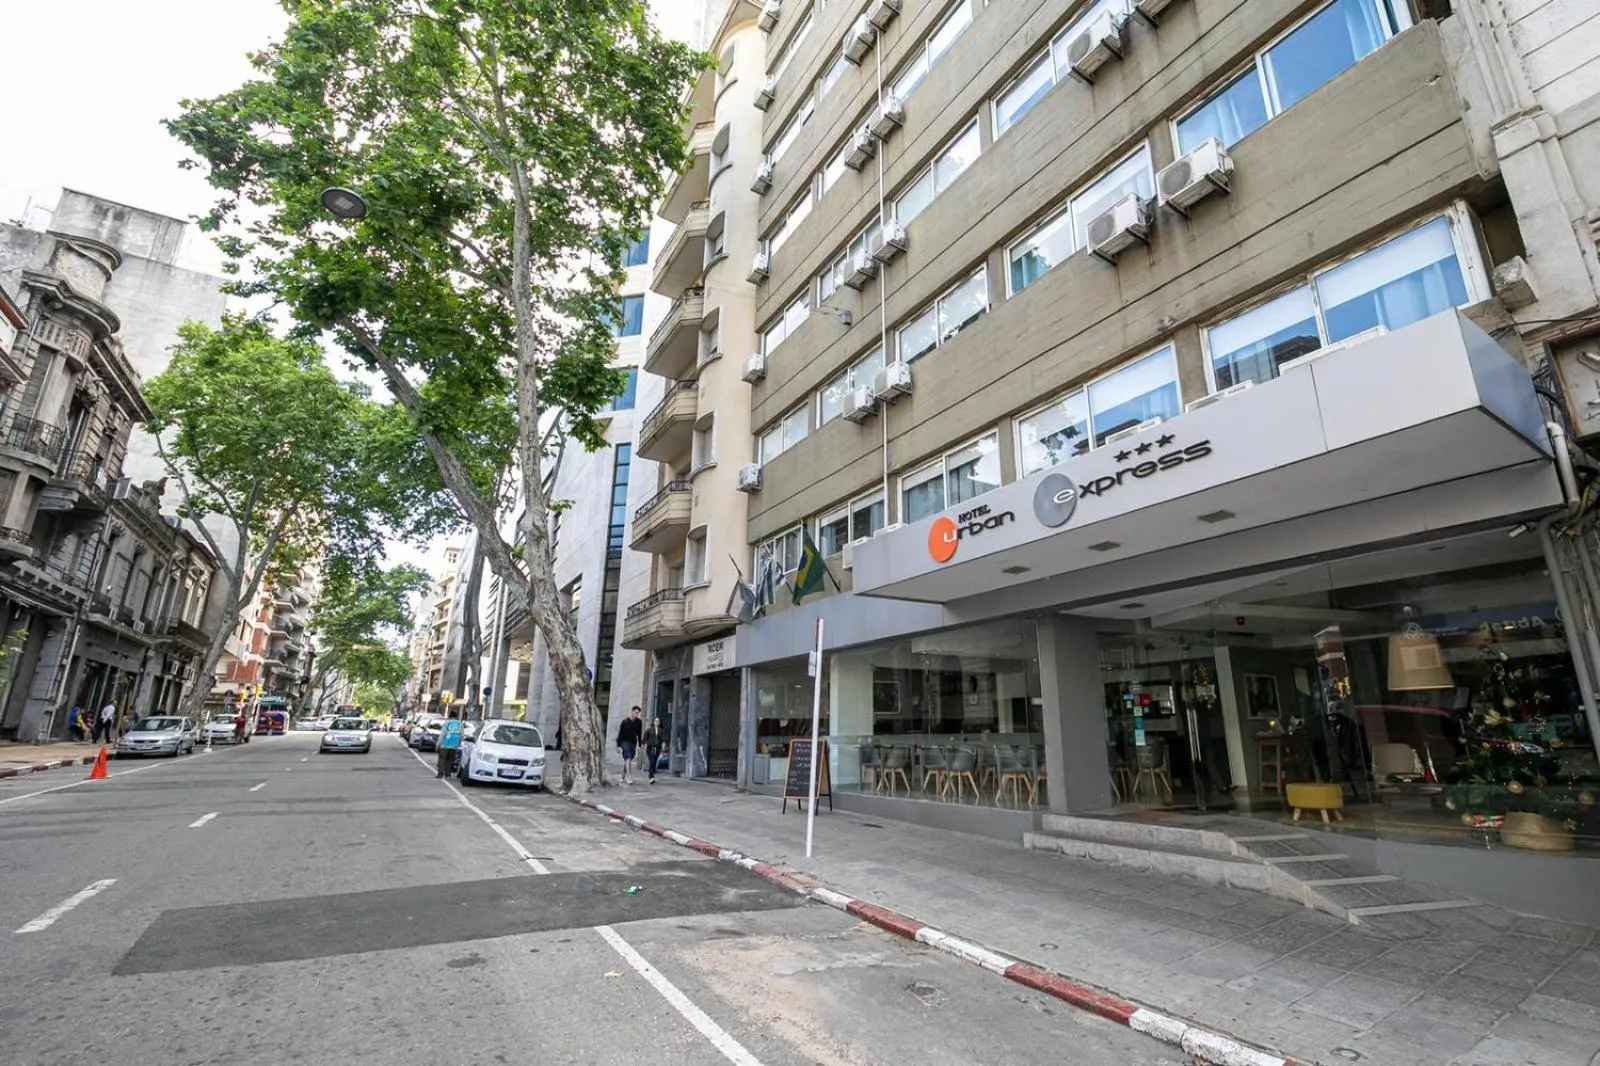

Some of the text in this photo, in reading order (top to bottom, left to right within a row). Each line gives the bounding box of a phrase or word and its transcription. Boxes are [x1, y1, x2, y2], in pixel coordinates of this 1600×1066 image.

[943, 439, 1212, 543] urban express
[958, 504, 991, 524] HOTEL
